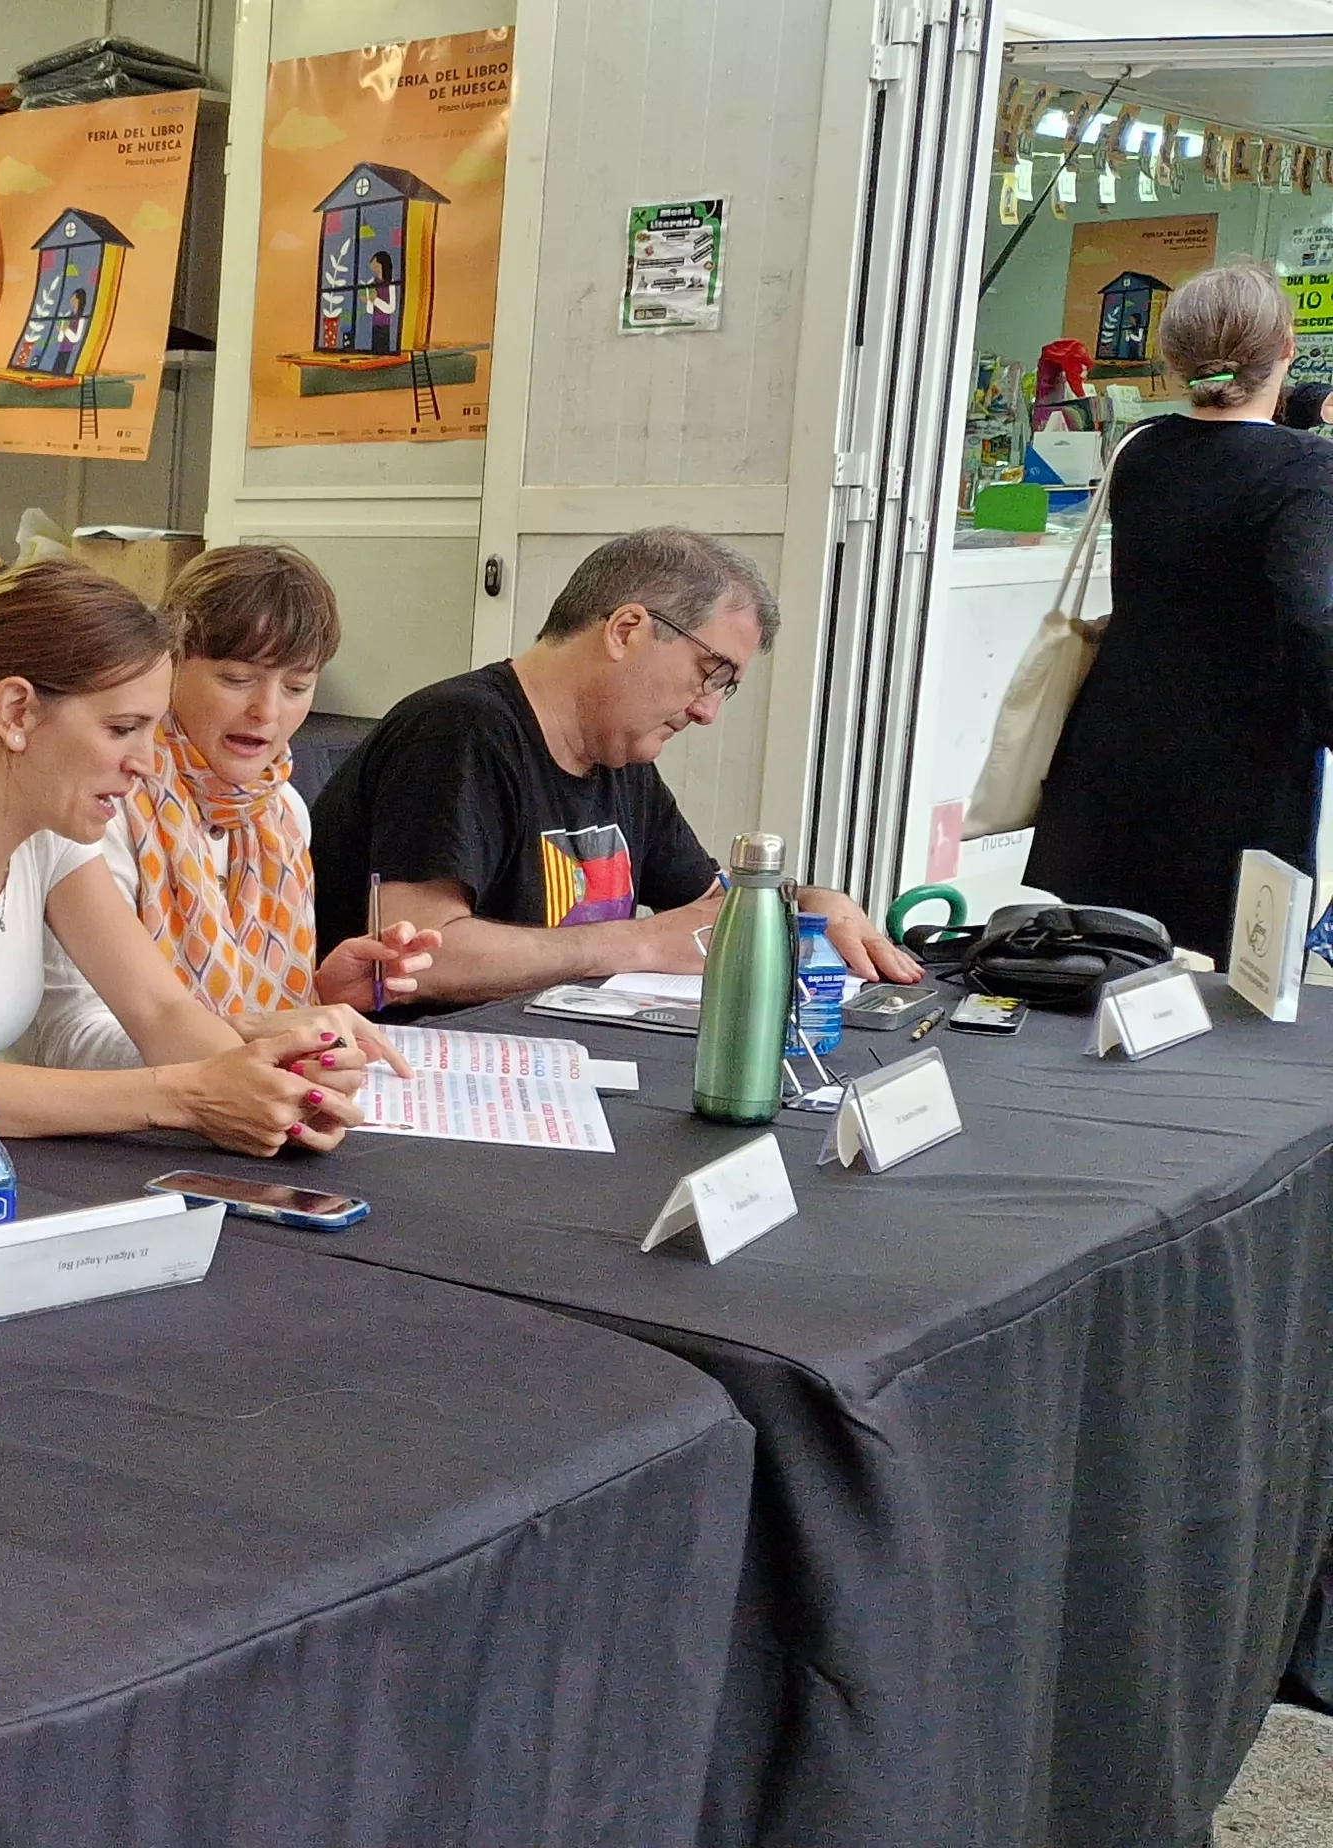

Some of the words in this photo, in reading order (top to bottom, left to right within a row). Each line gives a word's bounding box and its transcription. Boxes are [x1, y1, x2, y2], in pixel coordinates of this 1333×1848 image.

[435, 68, 460, 82] DEL
[466, 62, 509, 79] LIBRO
[429, 87, 446, 100] DE
[451, 80, 508, 98] HUESCA
[88, 130, 118, 143] FERIA
[123, 127, 145, 139] DEL
[151, 124, 184, 137] LIBRO
[117, 143, 133, 155] DE
[137, 139, 182, 153] HUESCA
[659, 207, 692, 218] Menú
[650, 218, 701, 229] Literario
[1287, 275, 1304, 286] DIA
[1310, 274, 1330, 285] DEL
[1296, 290, 1323, 310] 10
[1294, 317, 1333, 328] ESCUE
[105, 1250, 138, 1264] Miguel
[140, 1248, 149, 1257] D.
[58, 1261, 74, 1272] Buj
[76, 1257, 102, 1269] Ángel
